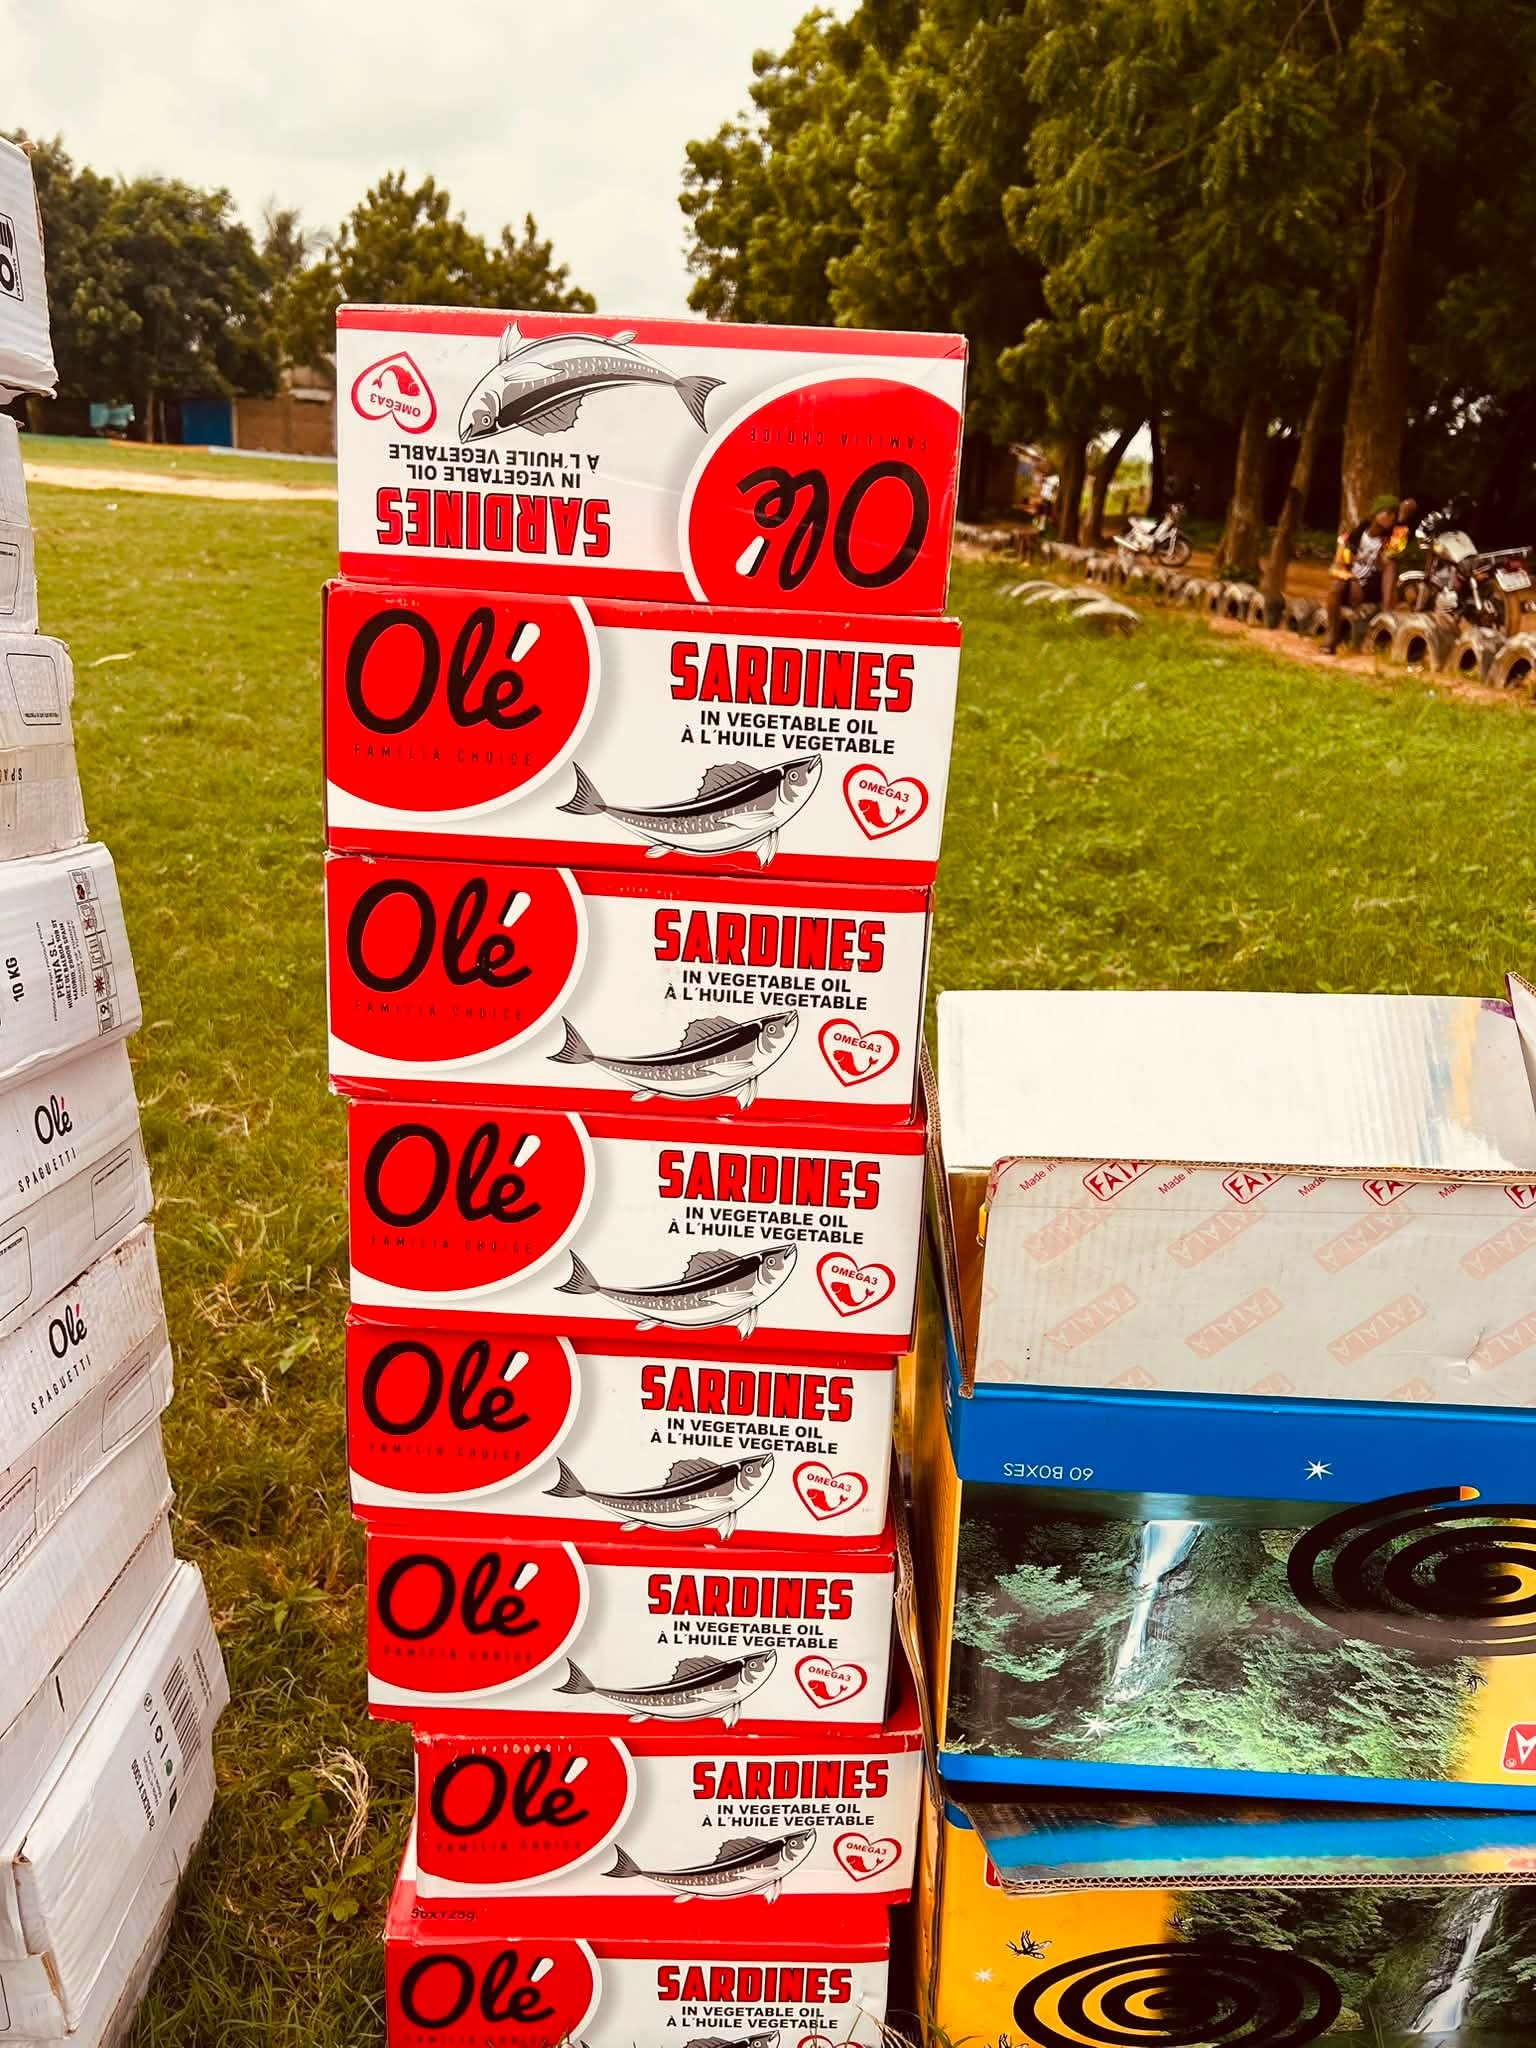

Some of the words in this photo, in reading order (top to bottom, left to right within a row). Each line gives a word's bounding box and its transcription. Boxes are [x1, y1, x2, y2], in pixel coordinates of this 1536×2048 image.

[369, 392, 421, 418] OMEGA3
[390, 444, 499, 464] VEGETABLE
[407, 465, 436, 480] OIL
[444, 467, 554, 486] VEGETABLE
[562, 473, 580, 488] IN
[376, 488, 611, 557] SARDINES
[735, 461, 929, 591] Olé
[345, 607, 543, 735] Olé
[671, 641, 915, 712] SARDINES
[701, 711, 719, 725] IN
[728, 712, 840, 732] VEGETABLE
[847, 719, 877, 734] OIL
[783, 734, 894, 754] VEGETABLE
[0, 767, 23, 782] SPA
[858, 779, 910, 803] OMEGA3
[346, 877, 533, 993] Olé
[654, 908, 885, 972] SARDINES
[6, 956, 23, 980] KG
[52, 959, 65, 999] PENTA
[13, 981, 25, 1002] 10
[684, 971, 701, 983] IN
[709, 972, 815, 995] VEGETABLE
[822, 979, 850, 992] OIL
[761, 992, 867, 1010] VEGETABLE
[832, 1031, 882, 1054] OMEGA3
[34, 1094, 73, 1145] Olé
[363, 1121, 543, 1228] Olé
[659, 1149, 881, 1210] SARDINES
[1020, 1170, 1047, 1191] Made
[1158, 1171, 1186, 1195] Made
[687, 1207, 703, 1219] IN
[711, 1208, 812, 1225] VEGETABLE
[820, 1215, 848, 1227] OIL
[761, 1227, 863, 1244] VEGETABLE
[831, 1264, 880, 1287] OMEGA3
[49, 1303, 88, 1359] Olé
[362, 1338, 530, 1436] Olé
[641, 1365, 855, 1422] SARDINES
[668, 1418, 684, 1430] IN
[691, 1420, 789, 1440] VEGETABLE
[796, 1426, 822, 1438] OIL
[739, 1438, 837, 1458] VEGETABLE
[1003, 1462, 1064, 1480] BOXES
[1069, 1467, 1094, 1481] 60
[806, 1472, 852, 1494] OMEGA3
[376, 1552, 540, 1640] Olé
[648, 1574, 853, 1620] SARDINES
[674, 1621, 689, 1631] IN
[696, 1622, 791, 1634] VEGETABLE
[798, 1625, 823, 1635] OIL
[743, 1636, 837, 1648] VEGETABLE
[808, 1666, 852, 1682] OMEGA3
[693, 1760, 889, 1800] SARDINES
[430, 1751, 589, 1837] Olé
[718, 1805, 733, 1814] IN
[740, 1804, 829, 1814] VEGETABLE
[836, 1804, 860, 1813] OIL
[784, 1816, 874, 1826] VEGETABLE
[846, 1841, 888, 1856] OMEGA3
[401, 1950, 555, 2029] Olé
[657, 1966, 852, 2004] SARDINES
[683, 2007, 697, 2015] IN
[704, 2007, 793, 2016] VEGETABLE
[800, 2008, 824, 2017] OIL
[748, 2019, 837, 2028] VEGETABLE
